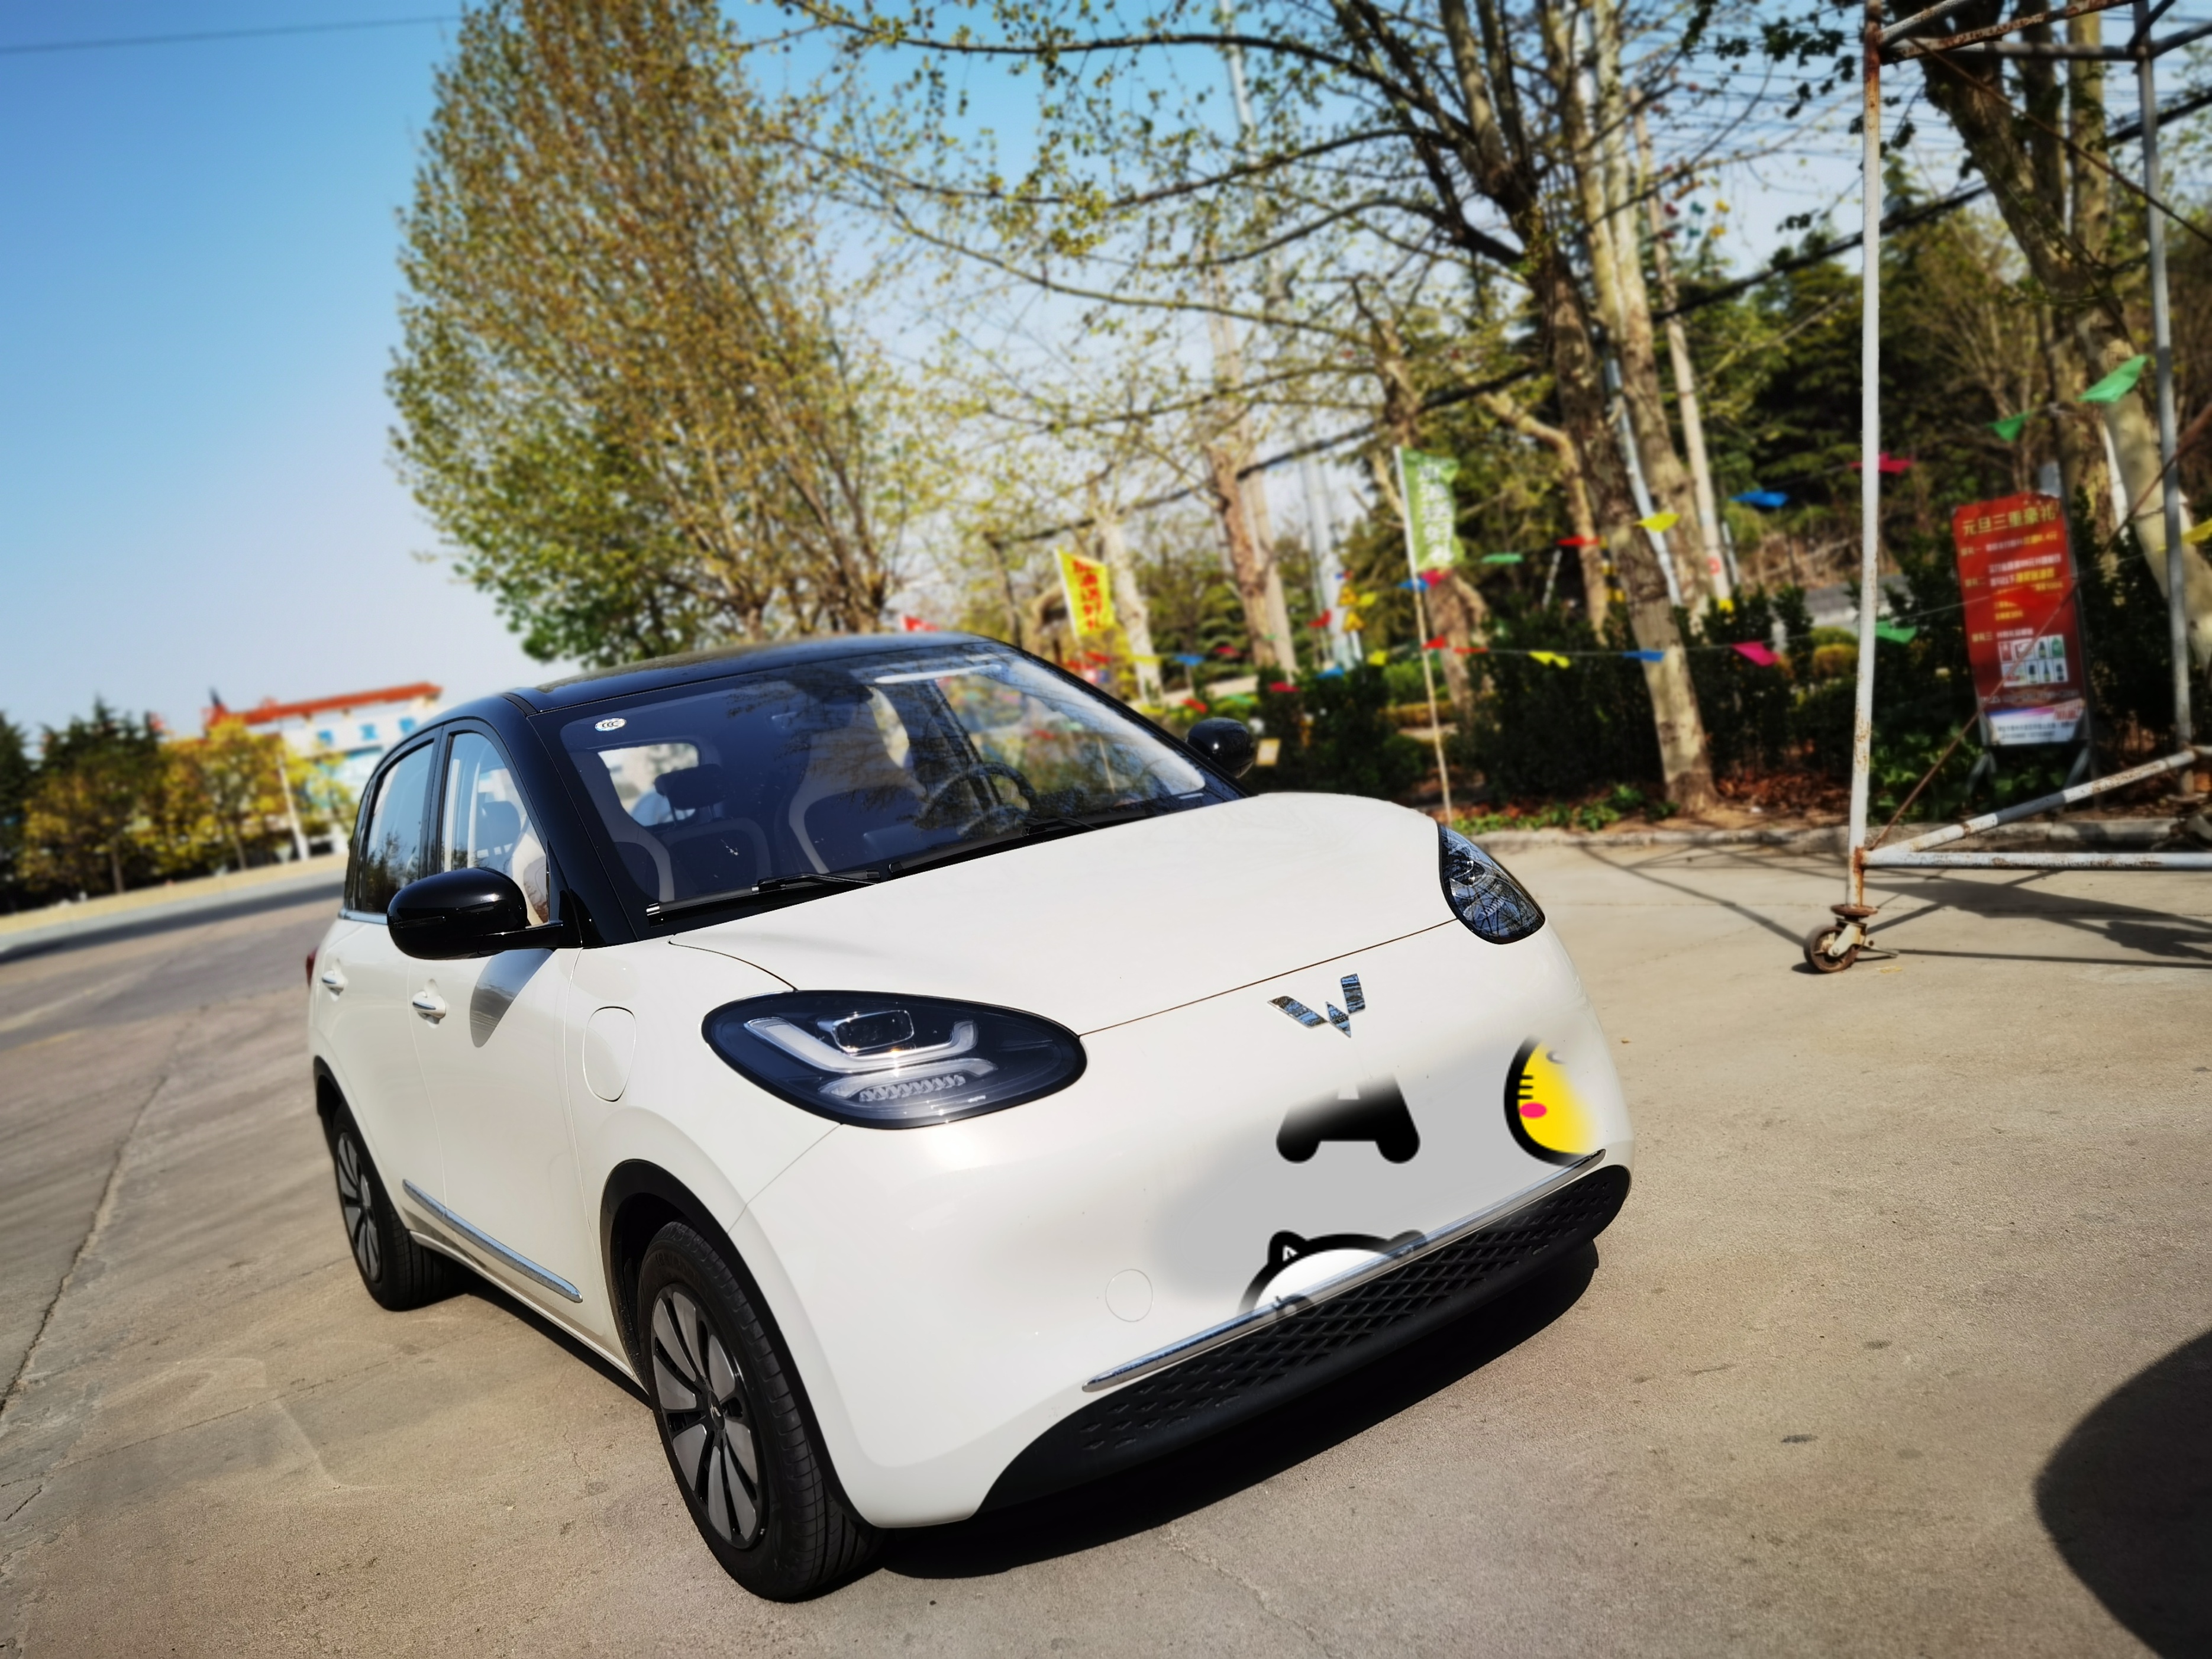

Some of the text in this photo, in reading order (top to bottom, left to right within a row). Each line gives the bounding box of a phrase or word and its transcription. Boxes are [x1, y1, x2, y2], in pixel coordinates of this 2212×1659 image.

[1962, 503, 2056, 537] 元旦三重豪礼
